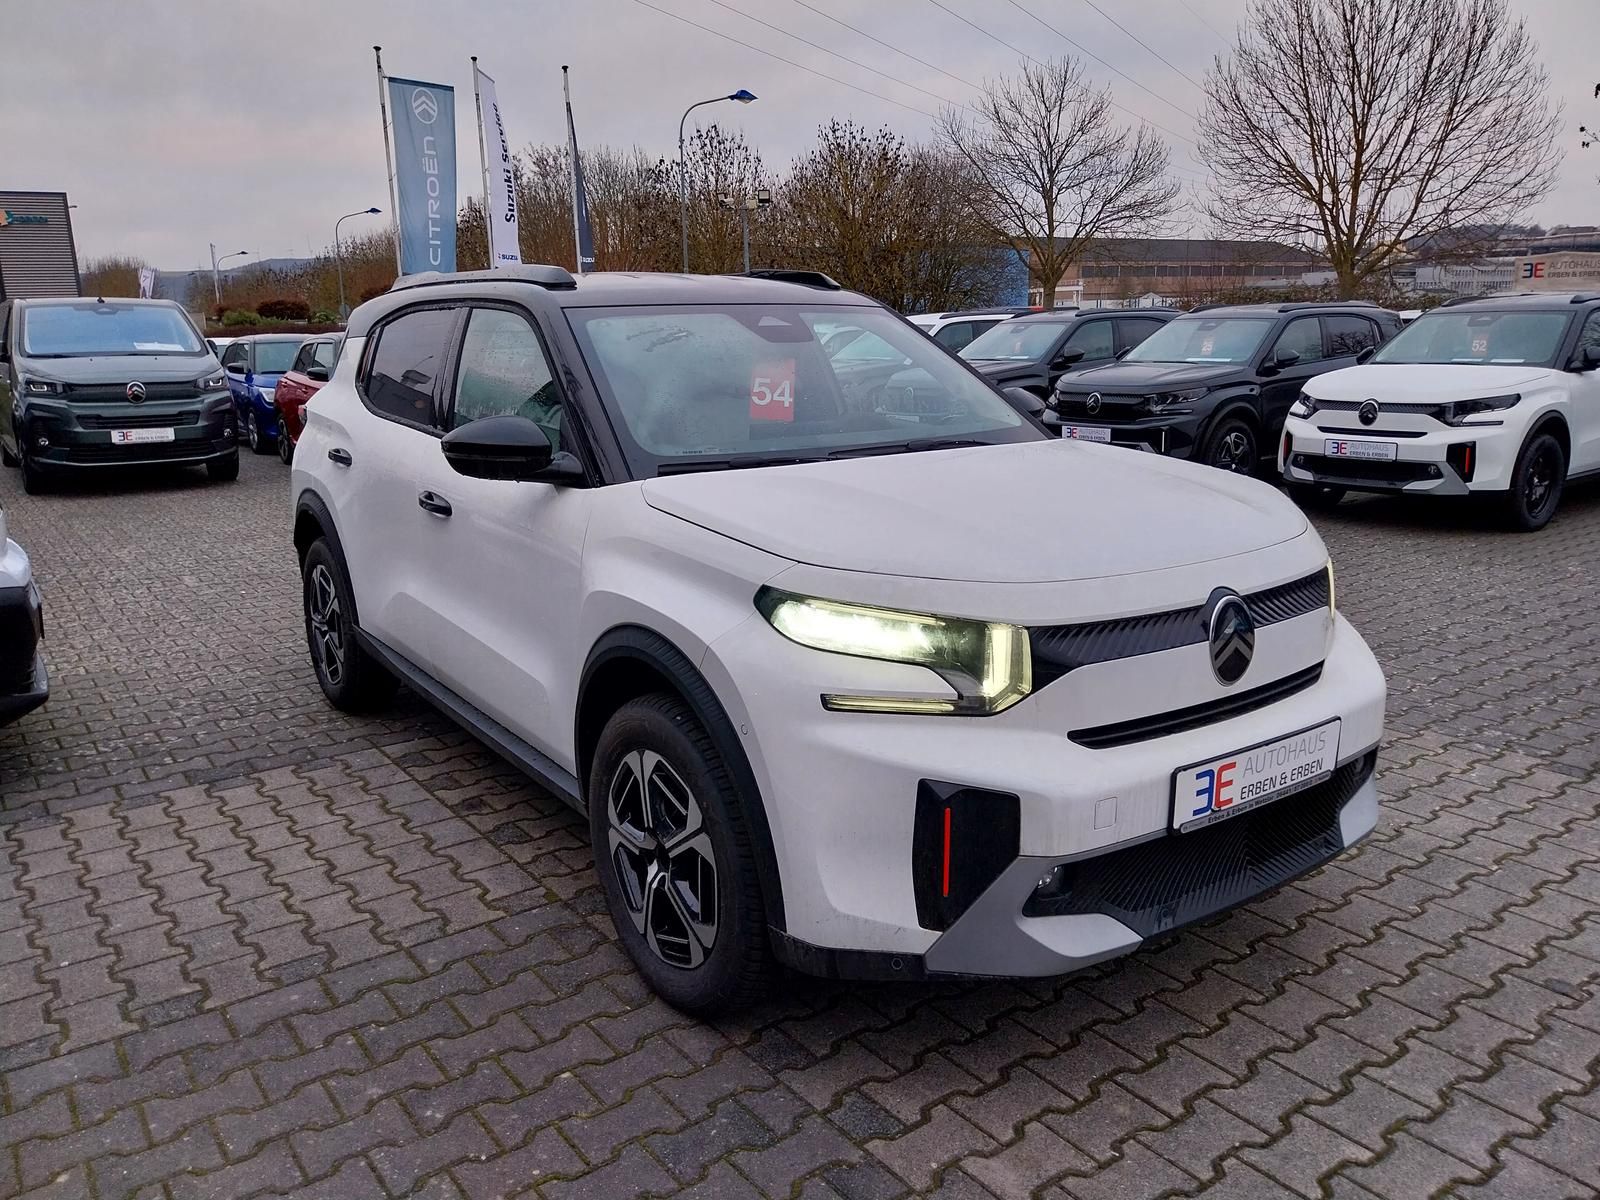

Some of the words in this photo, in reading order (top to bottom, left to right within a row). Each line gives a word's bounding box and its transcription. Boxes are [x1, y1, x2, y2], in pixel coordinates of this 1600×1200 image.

[492, 102, 510, 163] Service
[503, 168, 516, 223] Suzuki
[1472, 340, 1486, 352] 52
[751, 377, 793, 407] 54
[1243, 730, 1327, 777] AUTOHAUS
[1240, 775, 1278, 800] ERBEN
[1280, 772, 1288, 786] &
[1290, 757, 1324, 781] ERBEN
[1208, 814, 1225, 824] Erben
